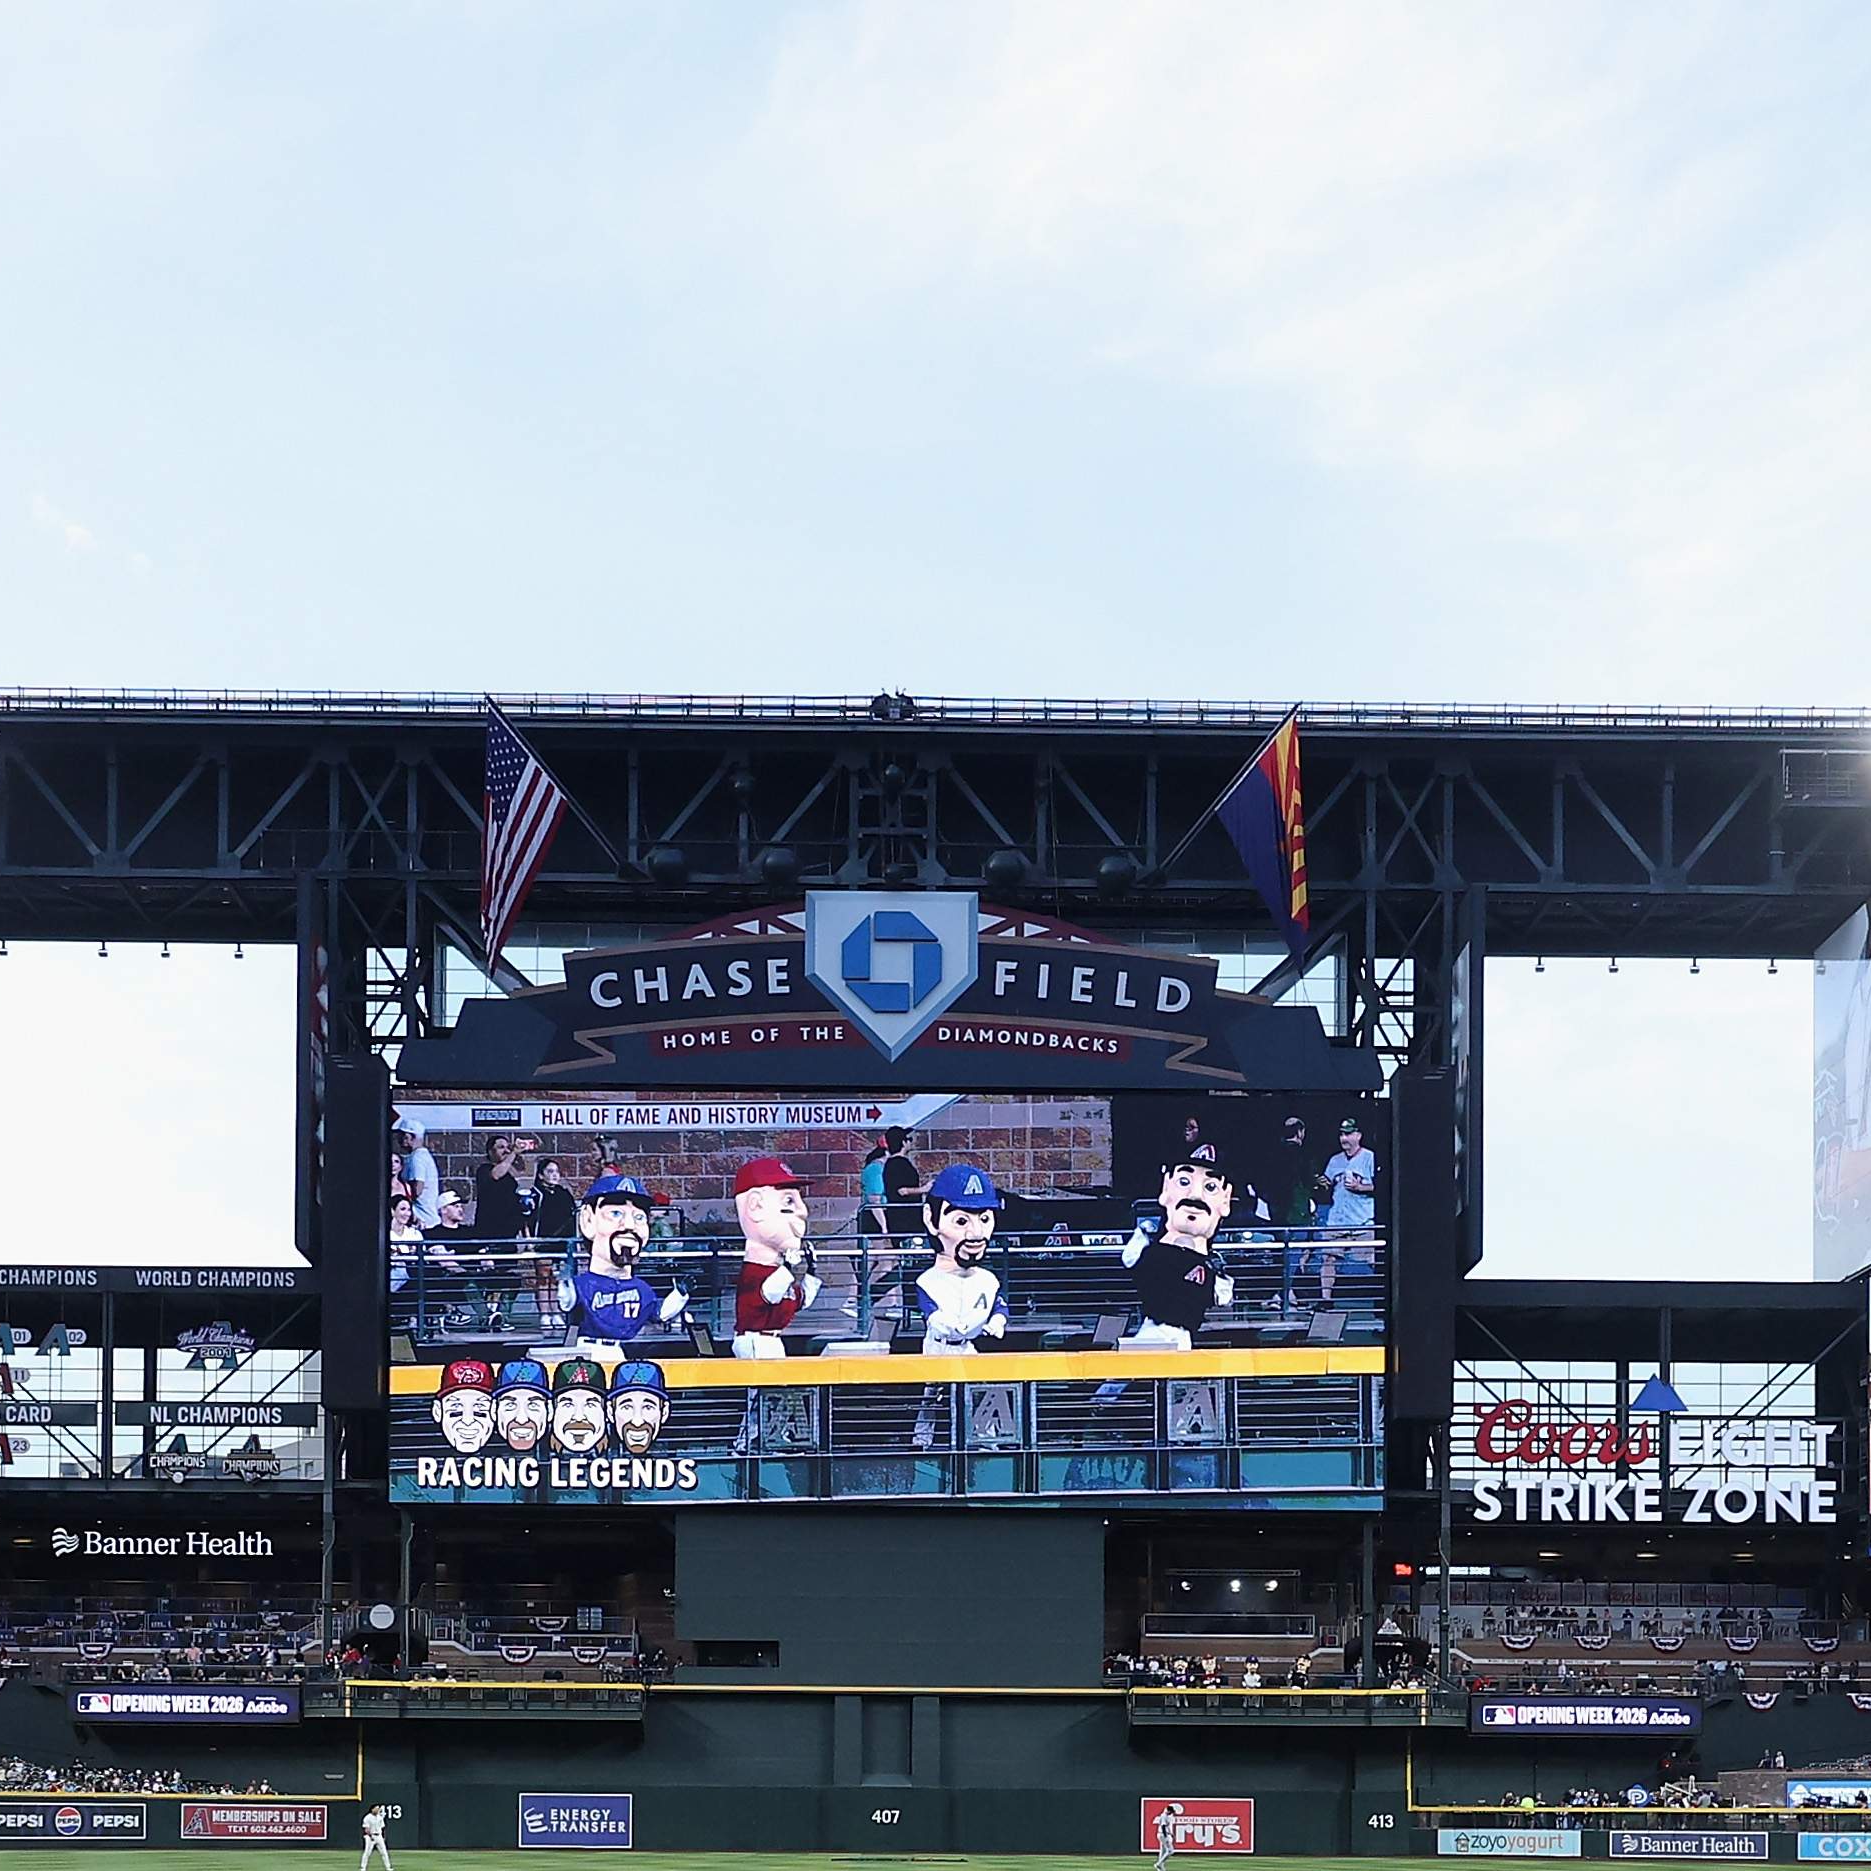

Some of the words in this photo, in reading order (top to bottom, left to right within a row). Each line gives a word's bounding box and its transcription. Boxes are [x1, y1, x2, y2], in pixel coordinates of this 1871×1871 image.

[591, 960, 790, 1011] CHASE
[995, 960, 1194, 1015] FIELD
[663, 1030, 732, 1050] HOME
[751, 1028, 779, 1044] OF
[799, 1025, 846, 1043] THE
[938, 1025, 1120, 1055] DIAMONDBACKS
[541, 1109, 584, 1126] HALL
[589, 1109, 610, 1125] OF
[616, 1108, 662, 1125] FAME
[667, 1107, 703, 1124] AND
[708, 1107, 780, 1124] HISTORY
[785, 1106, 862, 1124] MUSEUM
[135, 1270, 192, 1287] WORLD
[197, 1271, 296, 1288] CHAMPIONS
[5, 1405, 52, 1424] CARD
[149, 1406, 172, 1424] NL
[177, 1406, 282, 1424] CHAMPIONS
[1474, 1399, 1657, 1465] Coors
[1669, 1423, 1837, 1466] LIGHT
[418, 1457, 540, 1488] RACING
[550, 1457, 698, 1490] LEGENDS
[1473, 1480, 1663, 1523] STRIKE
[1682, 1481, 1837, 1524] ZONE
[83, 1531, 180, 1556] Banner
[185, 1531, 274, 1556] Health
[112, 1694, 172, 1713] OPENING
[172, 1694, 210, 1713] WEEK
[210, 1695, 244, 1713] 2026
[245, 1700, 288, 1714] Adobe
[1517, 1707, 1576, 1725] OPENING
[1576, 1707, 1613, 1725] WEEK
[1614, 1707, 1648, 1725] 2026
[1649, 1712, 1691, 1725] Adobe
[92, 1814, 141, 1829] PEPSI
[213, 1810, 279, 1822] MEMBERSHIPS
[283, 1810, 296, 1822] ON
[298, 1810, 321, 1823] SALE
[550, 1808, 610, 1821] ENERGY
[871, 1808, 900, 1825] 407
[1368, 1814, 1394, 1829] 413
[227, 1825, 248, 1833] TEXT
[550, 1821, 626, 1834] TRANSFER
[1641, 1837, 1697, 1853] Banner
[1702, 1837, 1755, 1853] Health
[1818, 1838, 1871, 1857] COX
